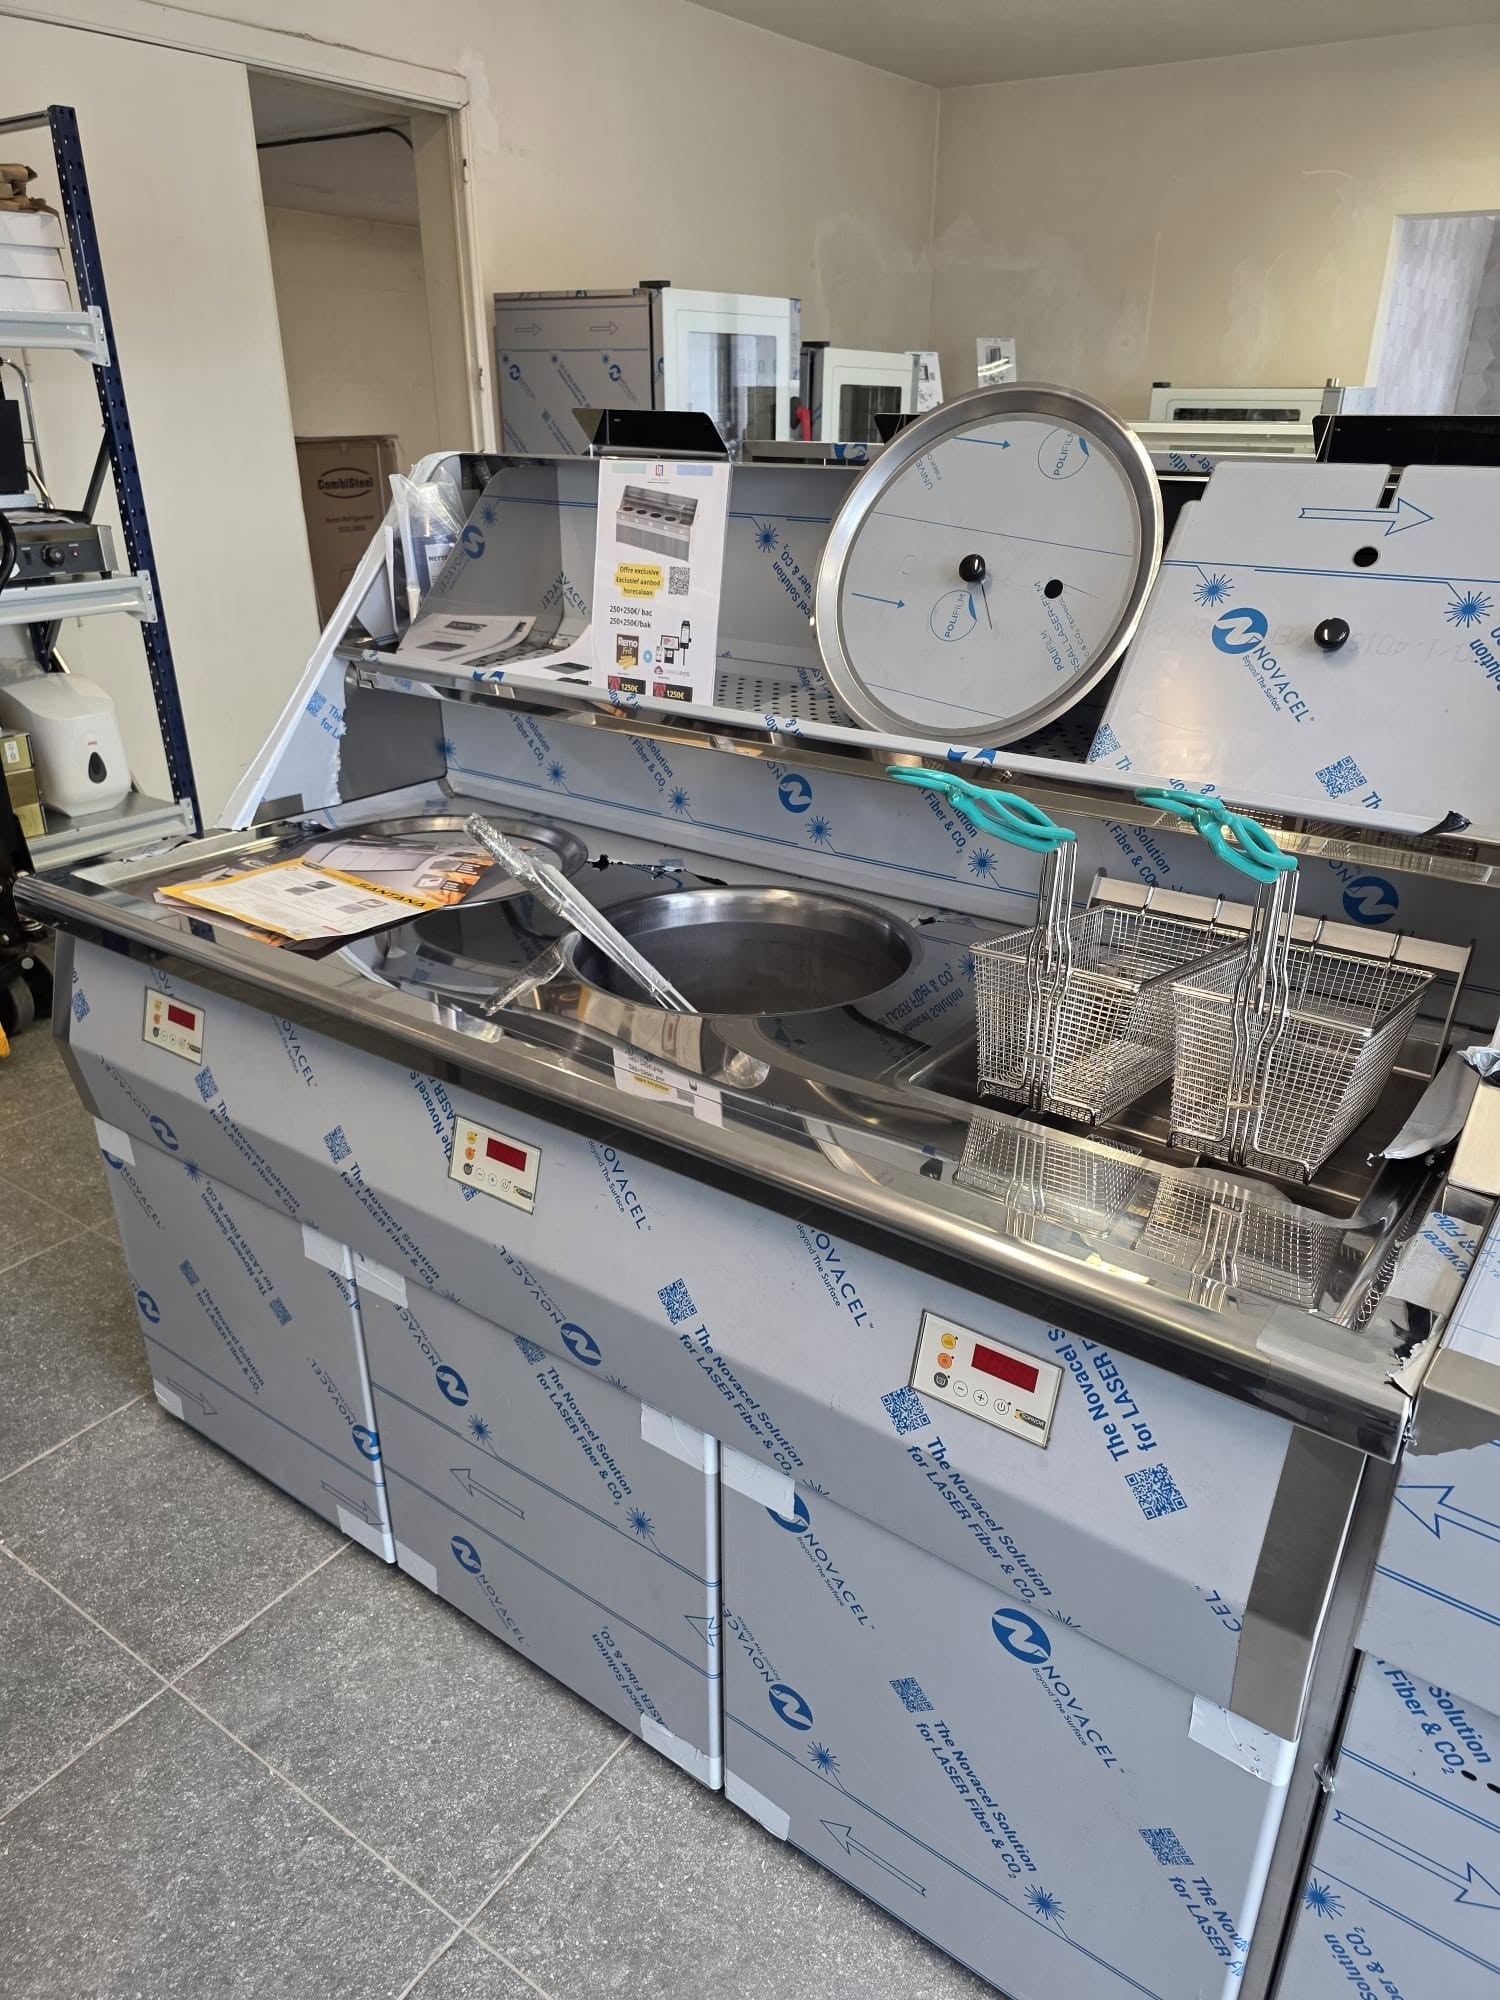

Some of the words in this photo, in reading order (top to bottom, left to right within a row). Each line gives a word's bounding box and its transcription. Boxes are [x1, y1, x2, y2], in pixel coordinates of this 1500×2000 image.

[615, 576, 639, 585] Exclusief
[640, 578, 661, 587] aanbod
[619, 566, 634, 574] Offre
[634, 567, 659, 576] exclusive
[772, 562, 800, 603] Solution
[641, 608, 653, 617] bac
[945, 592, 967, 638] POLIFILM
[618, 637, 638, 648] Remo
[1041, 630, 1064, 672] POLIFILM
[620, 682, 639, 693] 1250€
[666, 690, 685, 700] 1250€
[1242, 655, 1260, 678] Beyond
[1256, 675, 1267, 689] The
[1263, 688, 1281, 712] Surface
[1252, 645, 1310, 723] NOVACEL
[320, 717, 333, 734] for
[513, 716, 529, 740] Fiber
[528, 738, 536, 749] &
[525, 715, 551, 753] Solution
[632, 738, 649, 765] Fiber
[647, 763, 656, 774] &
[645, 739, 673, 779] Solution
[925, 791, 947, 821] Fiber
[944, 821, 952, 831] &
[1109, 824, 1135, 856] Fiber
[1131, 855, 1144, 867] &
[1133, 826, 1171, 875] Solution
[358, 882, 427, 908] SANTANA
[280, 1015, 315, 1087] OVACEL
[415, 1079, 444, 1135] Novacel
[209, 1108, 222, 1125] for
[223, 1125, 253, 1161] LASER
[252, 1159, 275, 1188] Fiber
[274, 1188, 283, 1198] &
[217, 1099, 231, 1122] The
[230, 1120, 265, 1166] Novacel
[265, 1165, 300, 1209] Solution
[201, 1192, 229, 1235] Solution
[599, 1144, 647, 1230] OVACEL
[223, 1212, 241, 1240] Fiber
[340, 1171, 354, 1189] for
[355, 1189, 387, 1229] LASER
[386, 1227, 410, 1256] Fiber
[410, 1257, 419, 1267] &
[349, 1161, 365, 1188] The
[364, 1187, 403, 1232] Novacel
[402, 1232, 440, 1280] Solution
[227, 1235, 255, 1277] Novacel
[240, 1240, 264, 1275] LASER
[262, 1275, 274, 1292] for
[499, 1244, 562, 1324] NOVACEL
[810, 1228, 868, 1327] OVACEL
[812, 1254, 824, 1272] The
[821, 1272, 841, 1307] Surface
[254, 1276, 268, 1297] The
[202, 1287, 214, 1306] The
[213, 1306, 239, 1345] Novacel
[238, 1345, 265, 1387] Solution
[205, 1307, 228, 1340] LASER
[226, 1340, 243, 1366] Fiber
[394, 1304, 438, 1367] NOVACE
[678, 1333, 698, 1354] for
[696, 1356, 735, 1402] LASER
[733, 1402, 764, 1437] Fiber
[762, 1439, 774, 1449] &
[694, 1323, 714, 1355] The
[712, 1356, 760, 1410] Novacel
[757, 1411, 804, 1468] Solution
[1055, 1343, 1110, 1422] Novacel
[1092, 1351, 1140, 1420] LASER
[536, 1372, 551, 1391] for
[549, 1392, 580, 1435] LASER
[577, 1435, 602, 1467] Fiber
[599, 1470, 609, 1480] &
[547, 1365, 565, 1391] The
[563, 1391, 600, 1442] Novacel
[597, 1443, 633, 1495] Solution
[1102, 1421, 1130, 1462] The
[1131, 1422, 1158, 1451] for
[907, 1445, 930, 1469] for
[926, 1470, 972, 1521] LASER
[967, 1522, 1004, 1560] Fiber
[1000, 1563, 1016, 1575] &
[927, 1435, 951, 1471] The
[948, 1472, 1004, 1532] Novacel
[998, 1534, 1053, 1597] Solution
[796, 1536, 817, 1563] Beyond
[814, 1563, 826, 1578] The
[823, 1577, 845, 1607] Surface
[803, 1533, 870, 1627] NOVACEL
[479, 1574, 525, 1644] NOVACEL
[592, 1633, 625, 1682] Solution
[613, 1649, 623, 1659] &
[721, 1602, 775, 1684] NOVACE
[622, 1661, 645, 1694] Fiber
[1384, 1668, 1429, 1718] Fiber
[1420, 1721, 1442, 1737] &
[1032, 1667, 1056, 1697] Beyond
[1052, 1697, 1066, 1714] The
[1063, 1714, 1088, 1747] Surface
[1041, 1665, 1118, 1769] NOVACEL
[1428, 1685, 1493, 1765] Solution
[916, 1722, 936, 1745] for
[931, 1745, 970, 1796] LASER
[964, 1797, 996, 1836] Fiber
[991, 1837, 1005, 1850] &
[934, 1719, 956, 1748] The
[951, 1750, 1000, 1809] Novacel
[992, 1810, 1038, 1873] Solution
[1168, 1876, 1193, 1901] for
[1186, 1904, 1232, 1958] LASER
[1191, 1876, 1217, 1906] The
[1366, 1961, 1386, 1975] &
